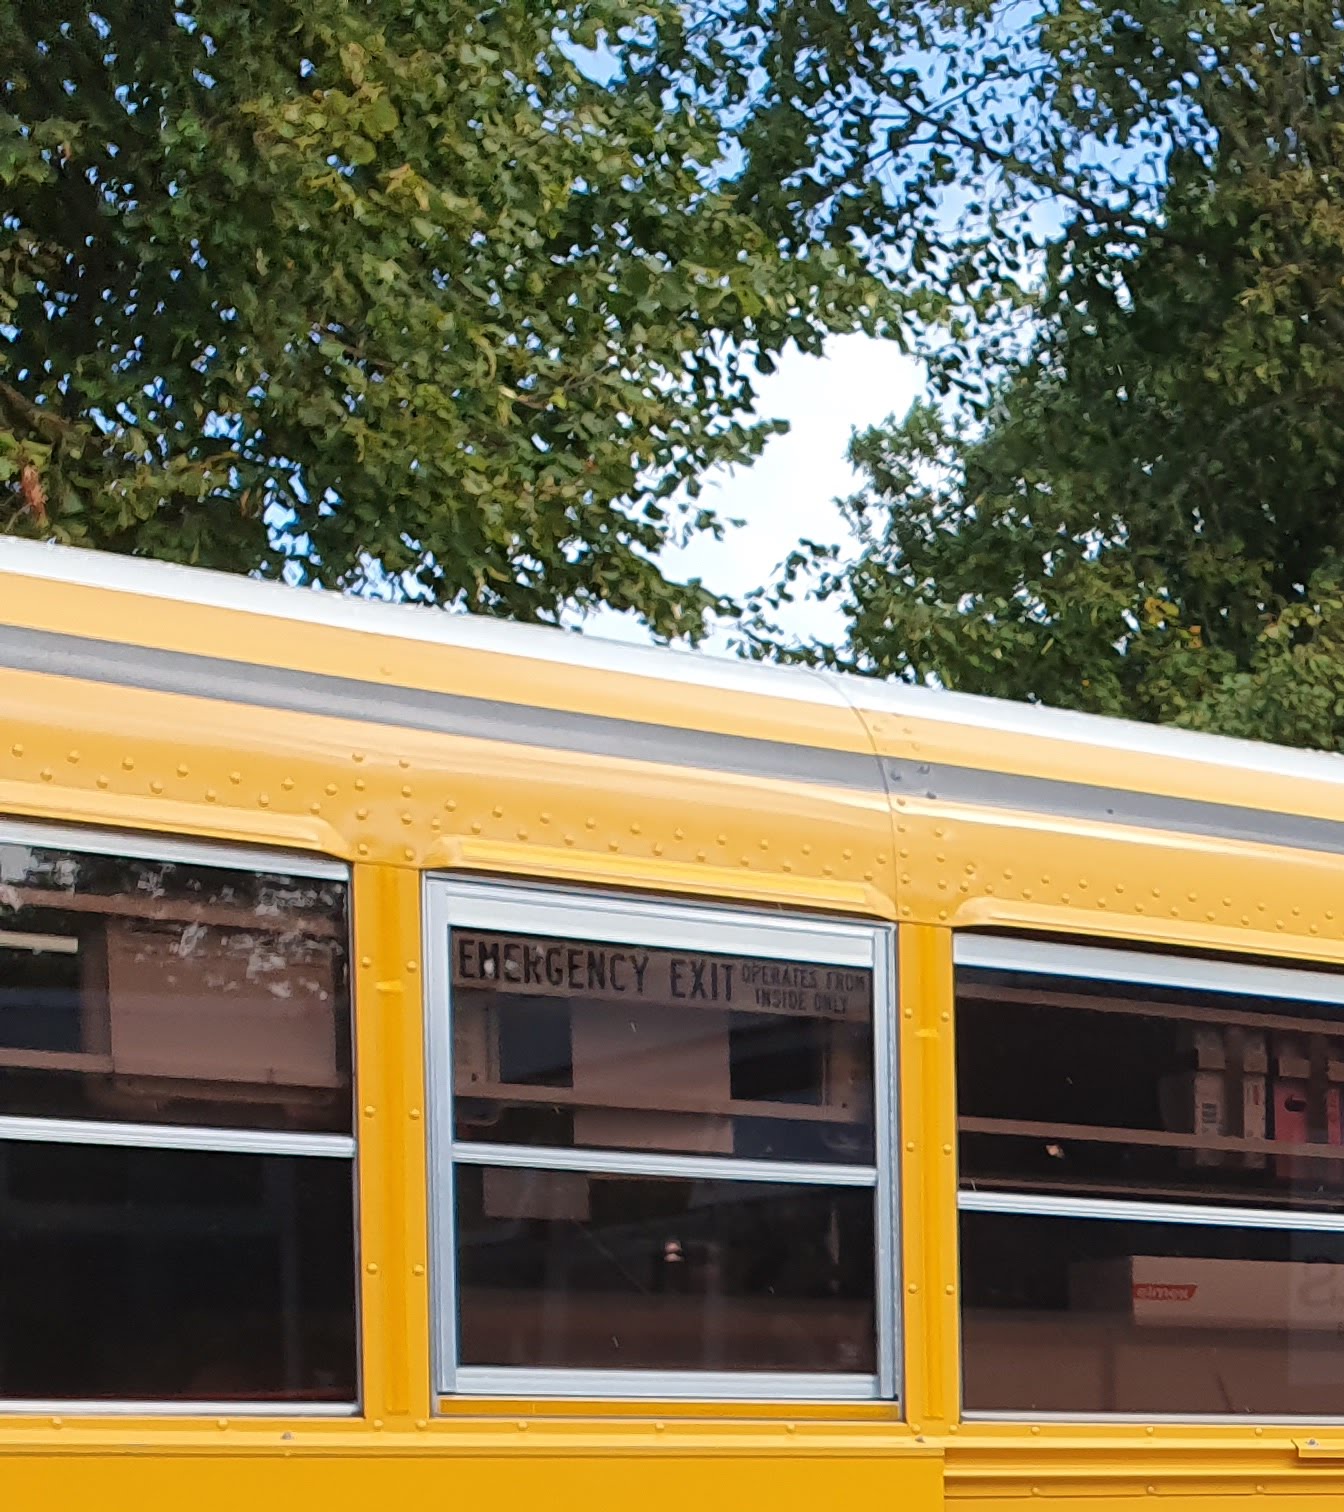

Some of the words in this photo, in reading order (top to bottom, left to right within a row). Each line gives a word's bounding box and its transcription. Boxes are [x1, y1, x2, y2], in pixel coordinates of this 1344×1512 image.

[458, 936, 649, 995] EMERGENCY
[669, 956, 734, 1002] EXIT
[742, 961, 817, 989] OPERATES
[826, 970, 866, 992] FROM
[755, 987, 807, 1011] INSIDE
[815, 991, 848, 1014] ONLY
